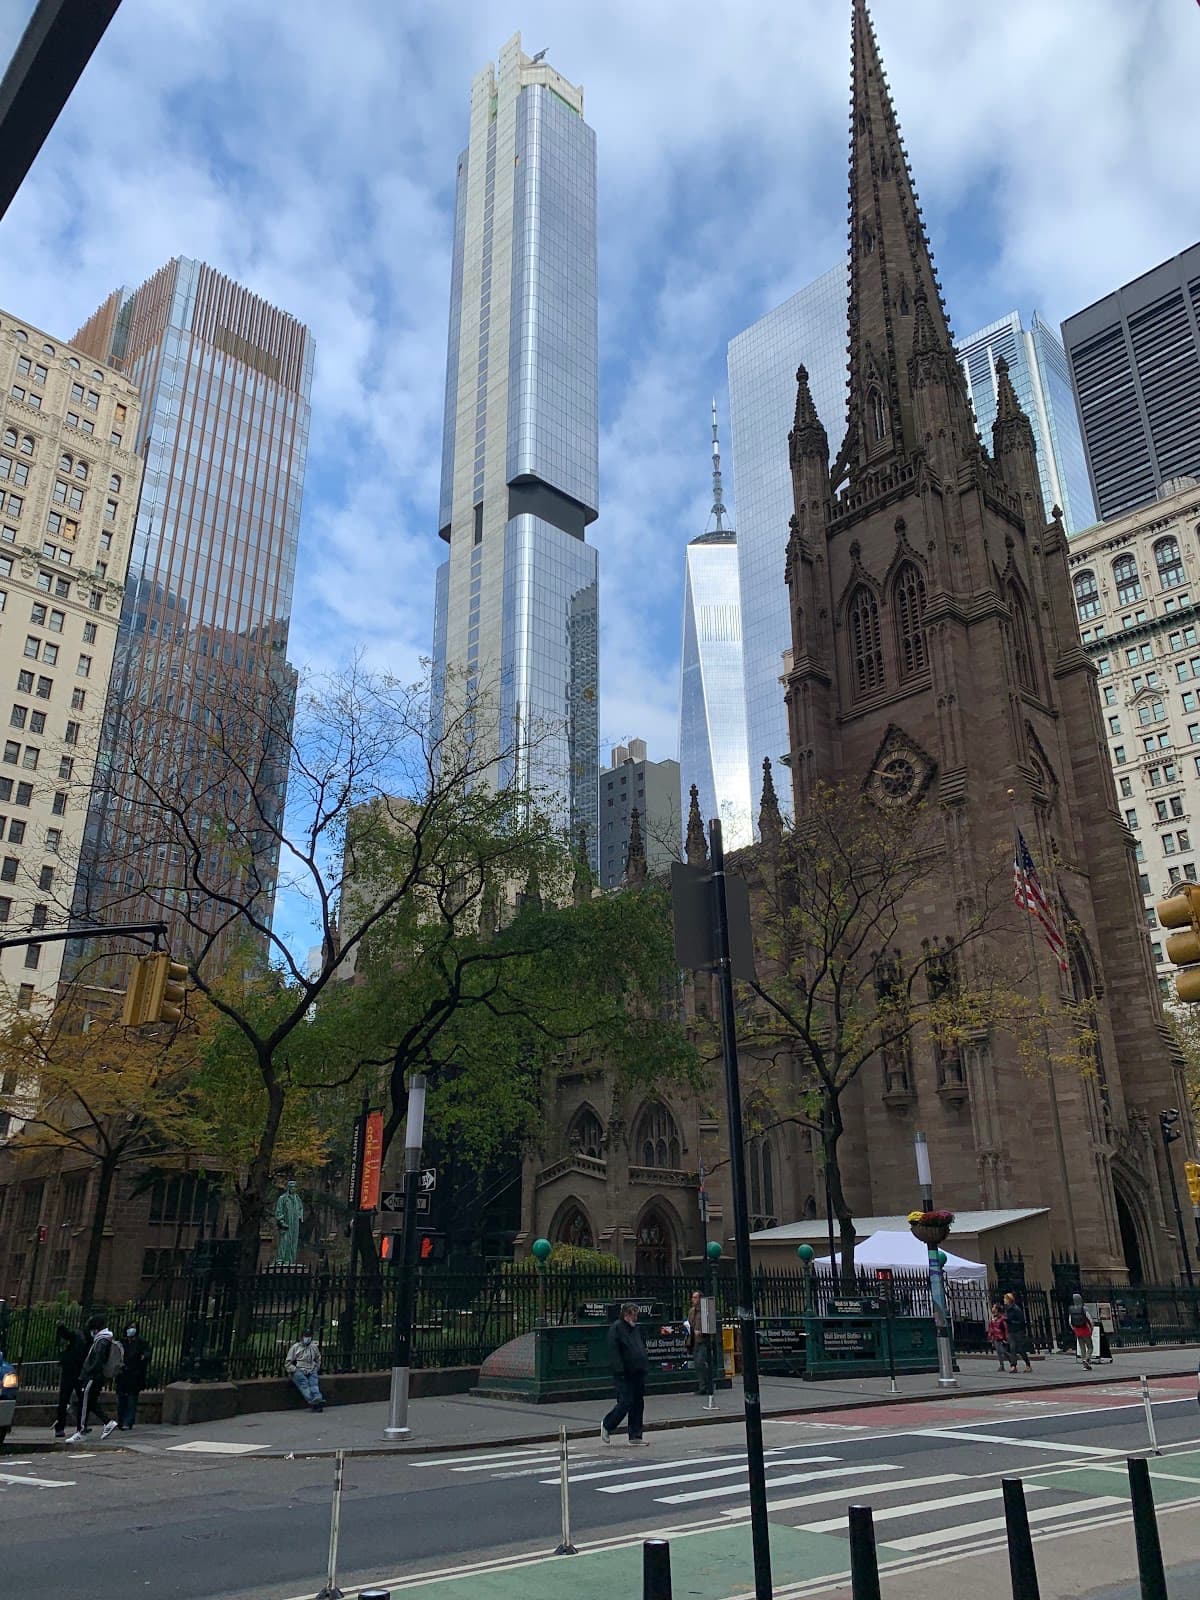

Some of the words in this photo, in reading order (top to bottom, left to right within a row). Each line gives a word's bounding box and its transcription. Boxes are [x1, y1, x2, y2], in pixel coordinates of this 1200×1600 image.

[824, 1332, 833, 1340] Wall
[834, 1332, 846, 1340] Street
[646, 1339, 658, 1348] Wall
[658, 1338, 674, 1347] Street
